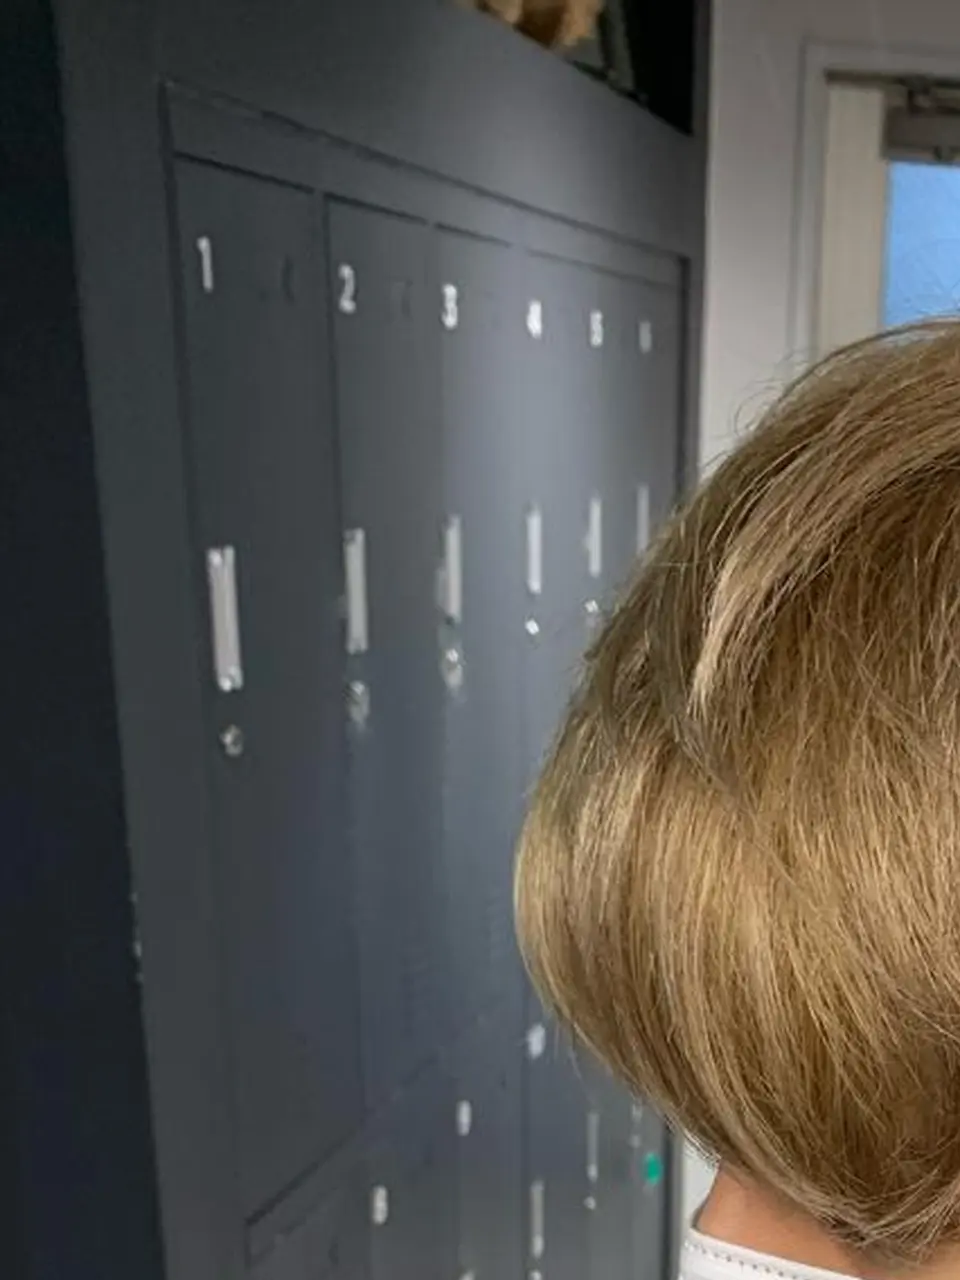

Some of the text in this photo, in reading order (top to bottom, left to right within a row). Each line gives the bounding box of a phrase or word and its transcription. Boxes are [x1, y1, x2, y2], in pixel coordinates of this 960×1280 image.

[196, 236, 213, 292] 1
[338, 263, 357, 314] 2
[441, 283, 458, 330] 3
